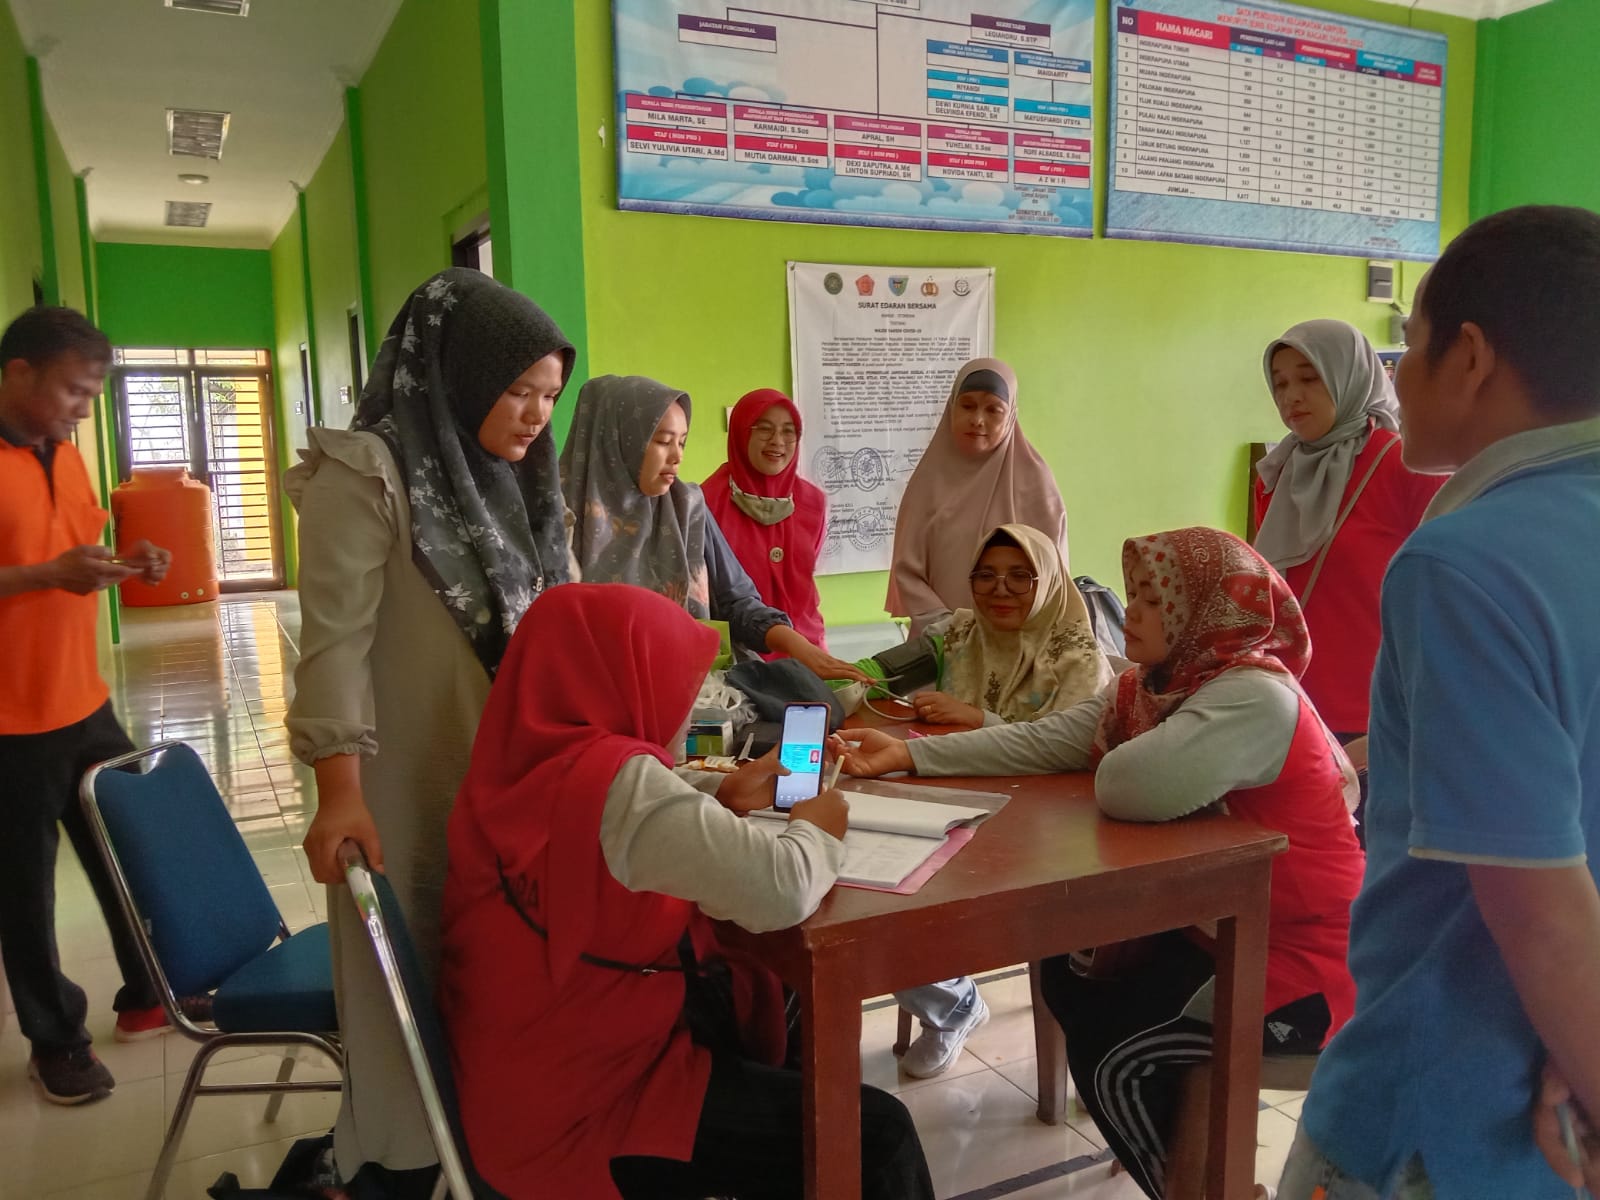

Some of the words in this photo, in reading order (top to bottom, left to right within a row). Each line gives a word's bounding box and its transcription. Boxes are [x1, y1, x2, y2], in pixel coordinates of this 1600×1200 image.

[1122, 16, 1134, 25] NO
[1155, 22, 1182, 34] NAMA
[1182, 26, 1213, 40] NAGARI
[647, 112, 666, 120] MILA
[652, 144, 680, 153] YULIVIA
[744, 151, 767, 159] MUTIA
[845, 167, 869, 175] LINTON
[942, 168, 965, 176] NOVIDA
